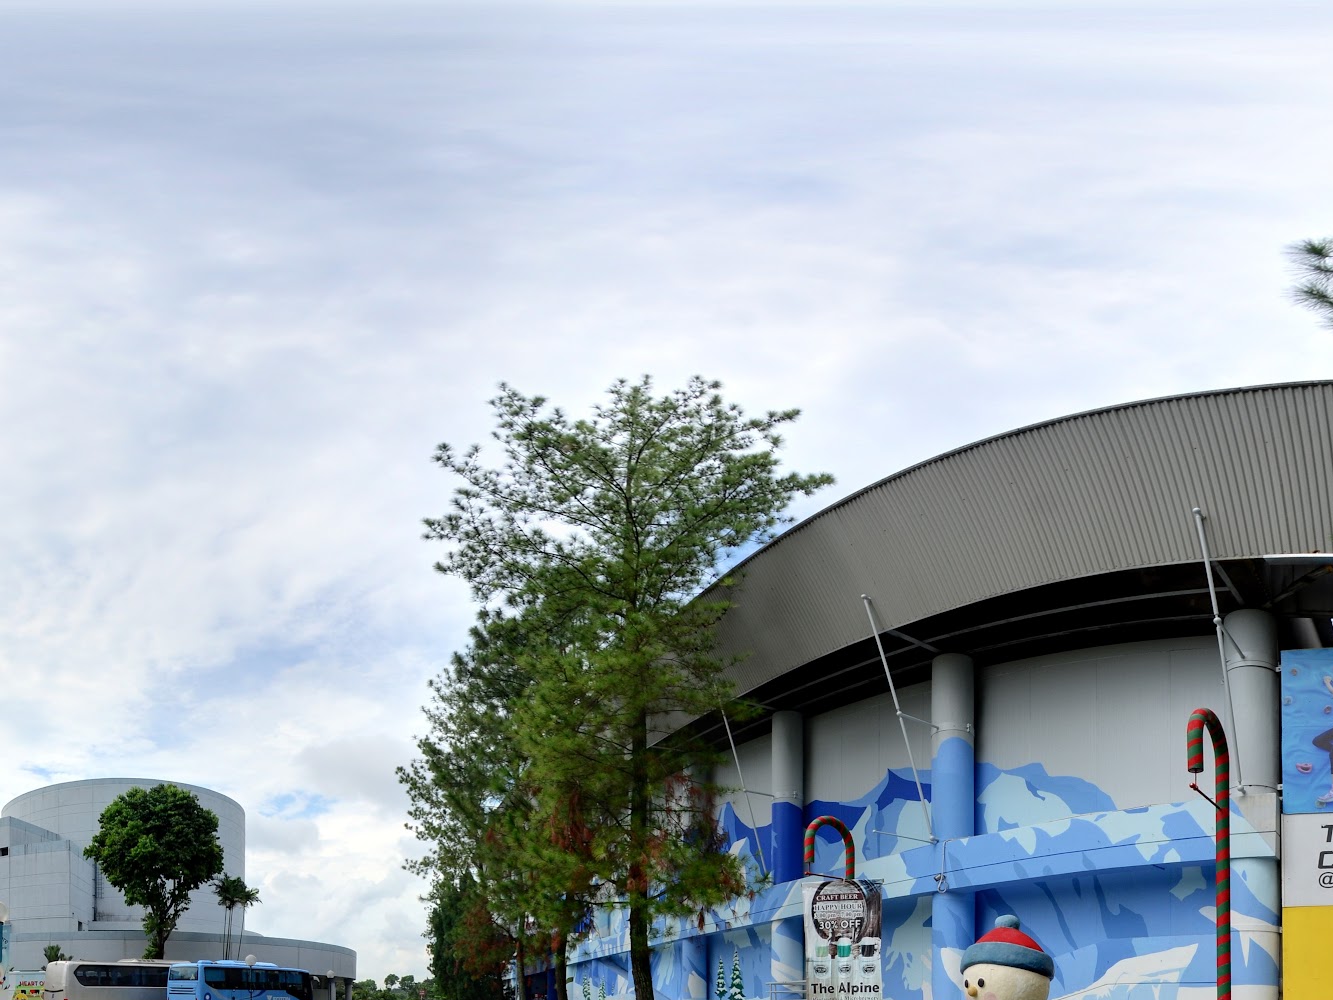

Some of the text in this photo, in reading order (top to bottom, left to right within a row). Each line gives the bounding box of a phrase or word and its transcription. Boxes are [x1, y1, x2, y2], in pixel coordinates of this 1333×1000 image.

[840, 902, 863, 910] HOUR
[819, 920, 861, 929] 30% OFF
[811, 982, 880, 995] The Alpine
